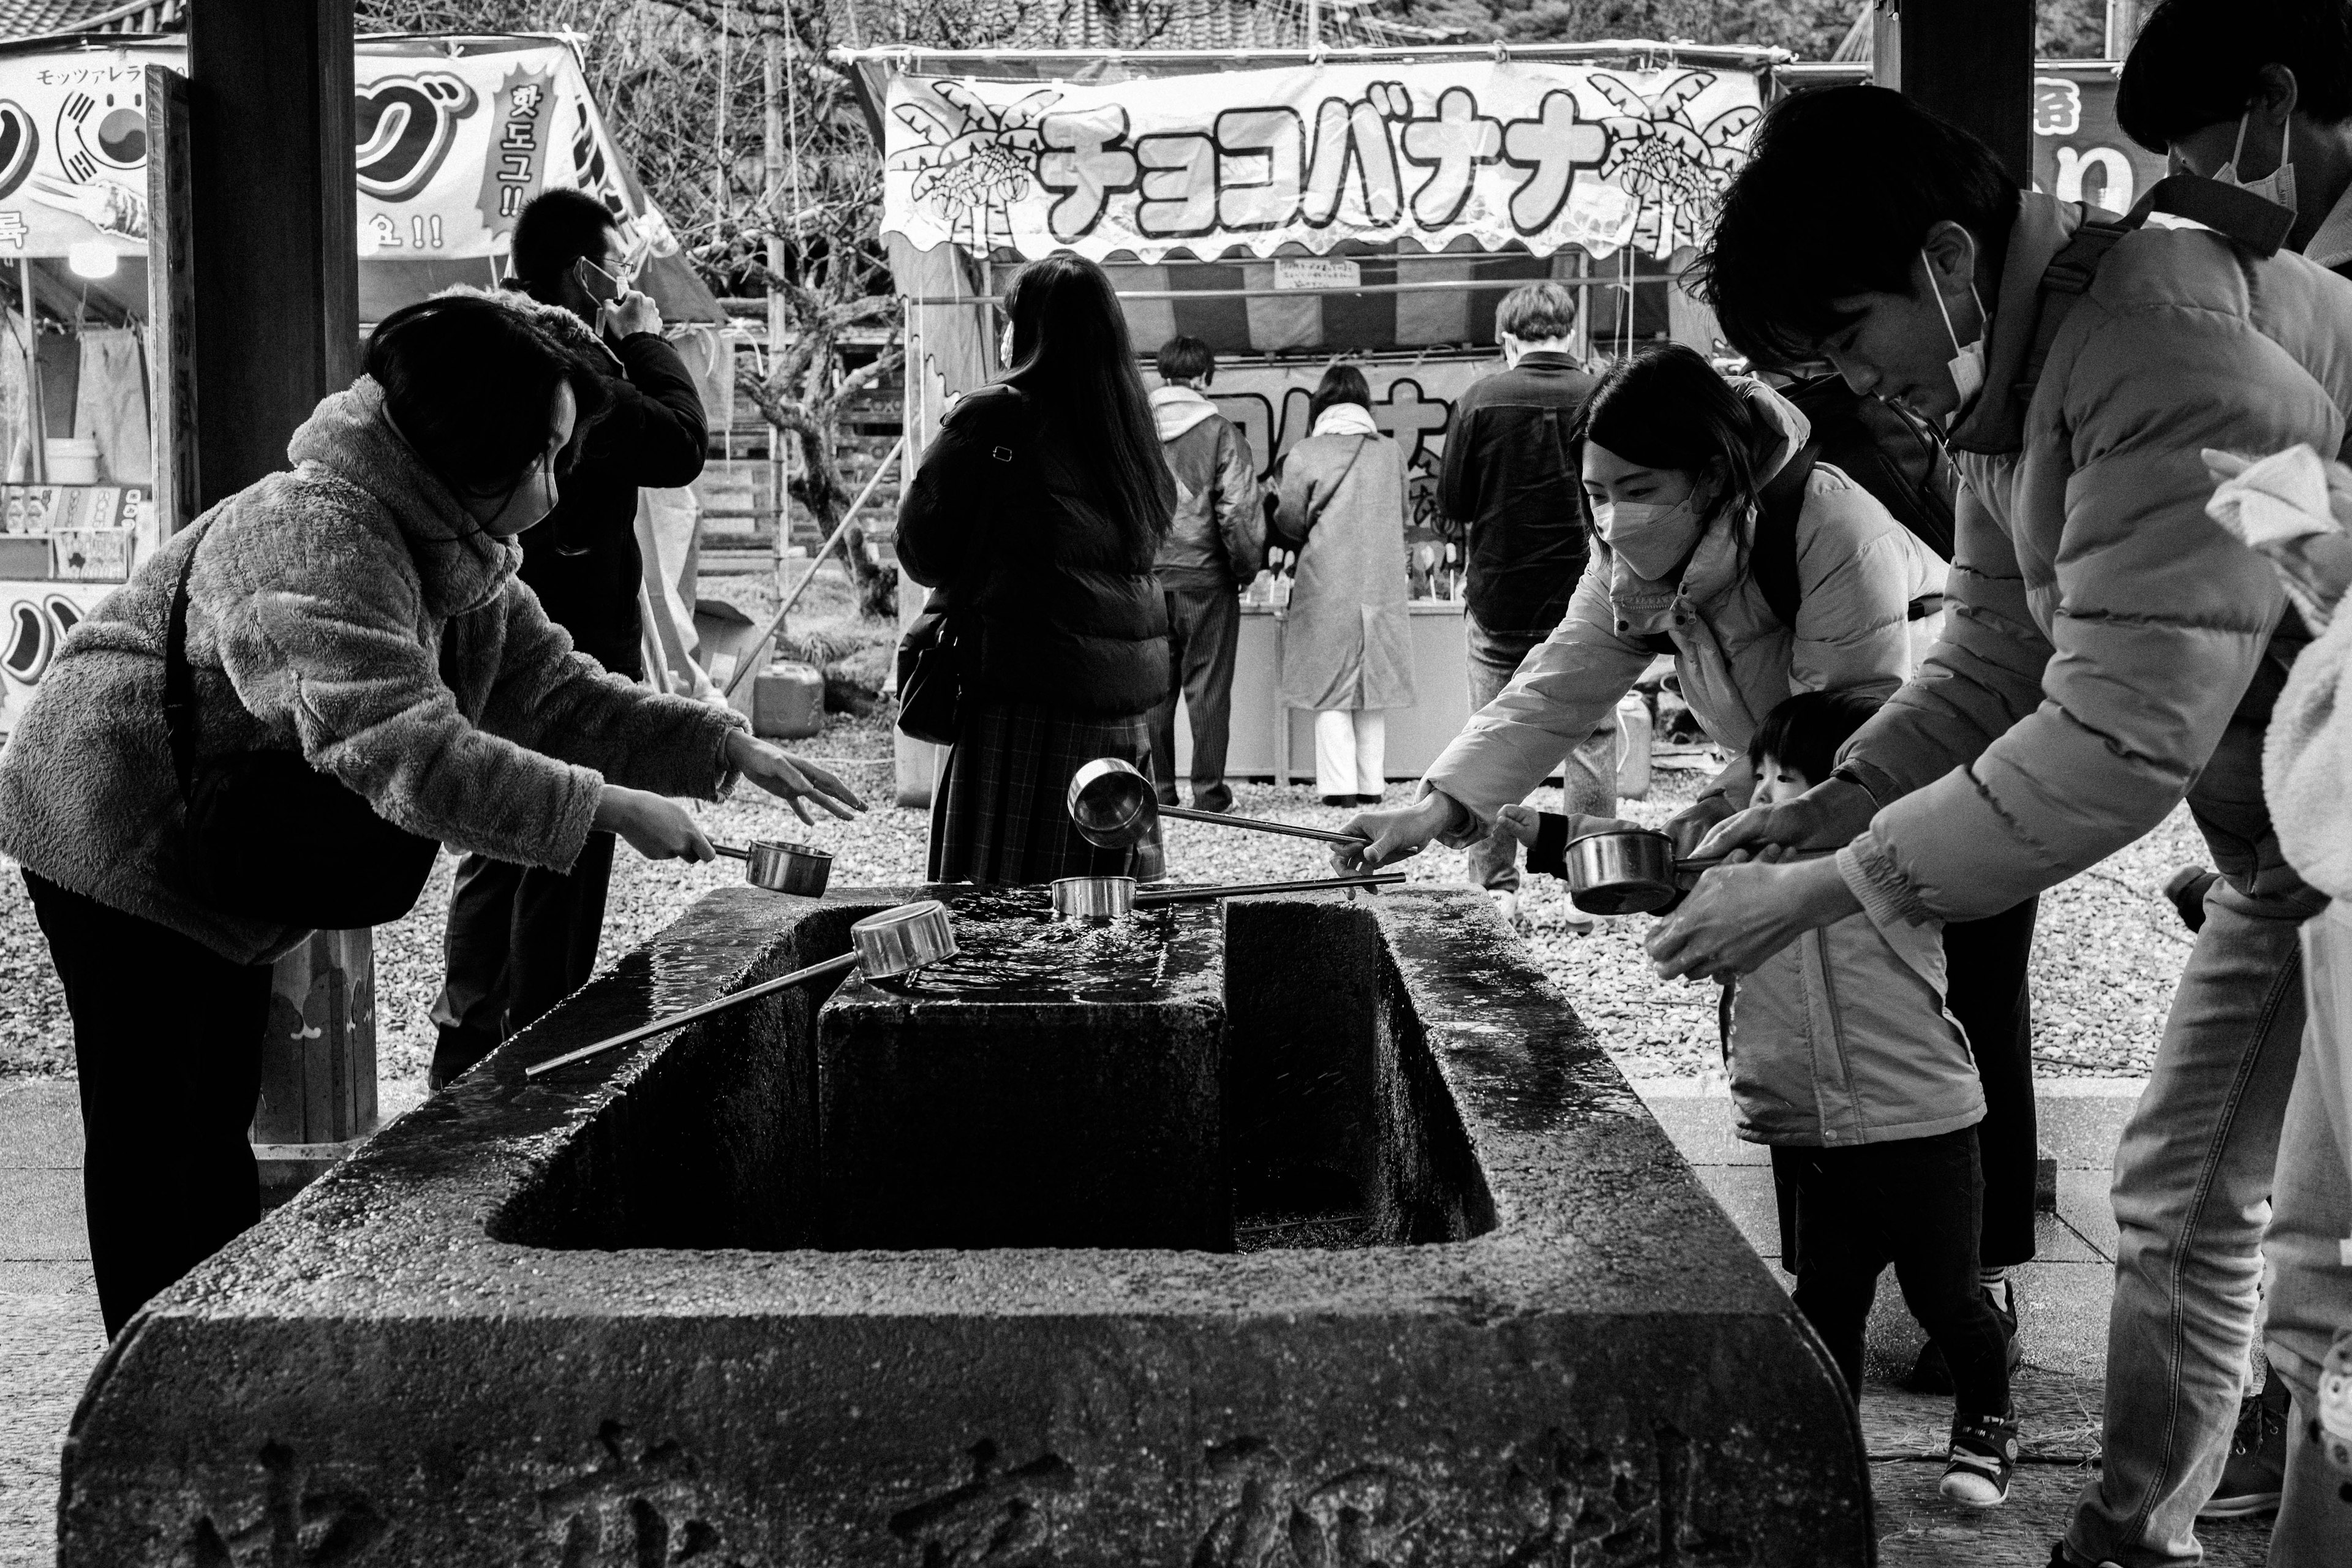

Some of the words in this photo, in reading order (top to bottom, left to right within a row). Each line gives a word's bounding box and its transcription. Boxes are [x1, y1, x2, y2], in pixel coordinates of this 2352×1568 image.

[1036, 80, 1613, 244] チョコバナナ
